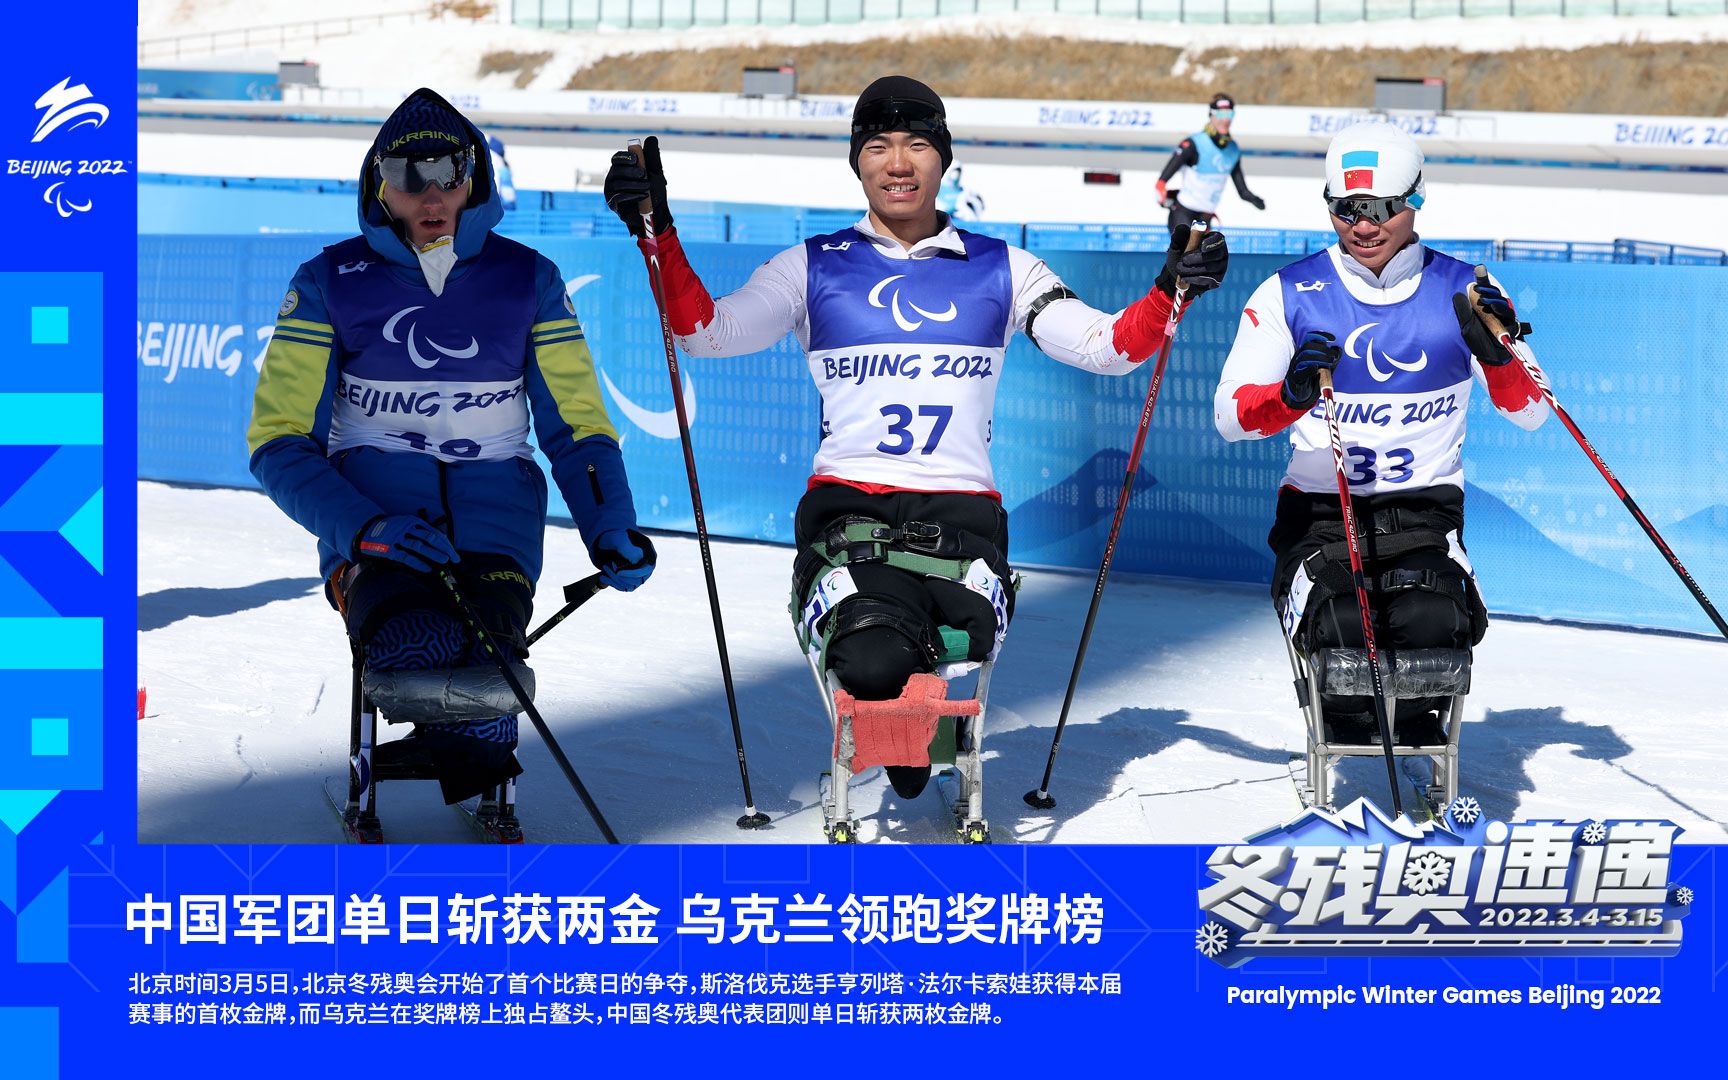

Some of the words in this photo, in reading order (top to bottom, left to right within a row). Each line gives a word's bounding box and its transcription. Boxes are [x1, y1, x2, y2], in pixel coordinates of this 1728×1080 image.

[1107, 109, 1154, 127] 2022
[1615, 123, 1694, 145] BEIJING
[386, 130, 461, 152] UKRAINE
[822, 353, 922, 385] BEIJING
[931, 354, 993, 380] 2022
[336, 379, 441, 418] BEIJING
[1400, 393, 1459, 426] 2022
[876, 403, 954, 456] 37
[1345, 446, 1416, 486] 33
